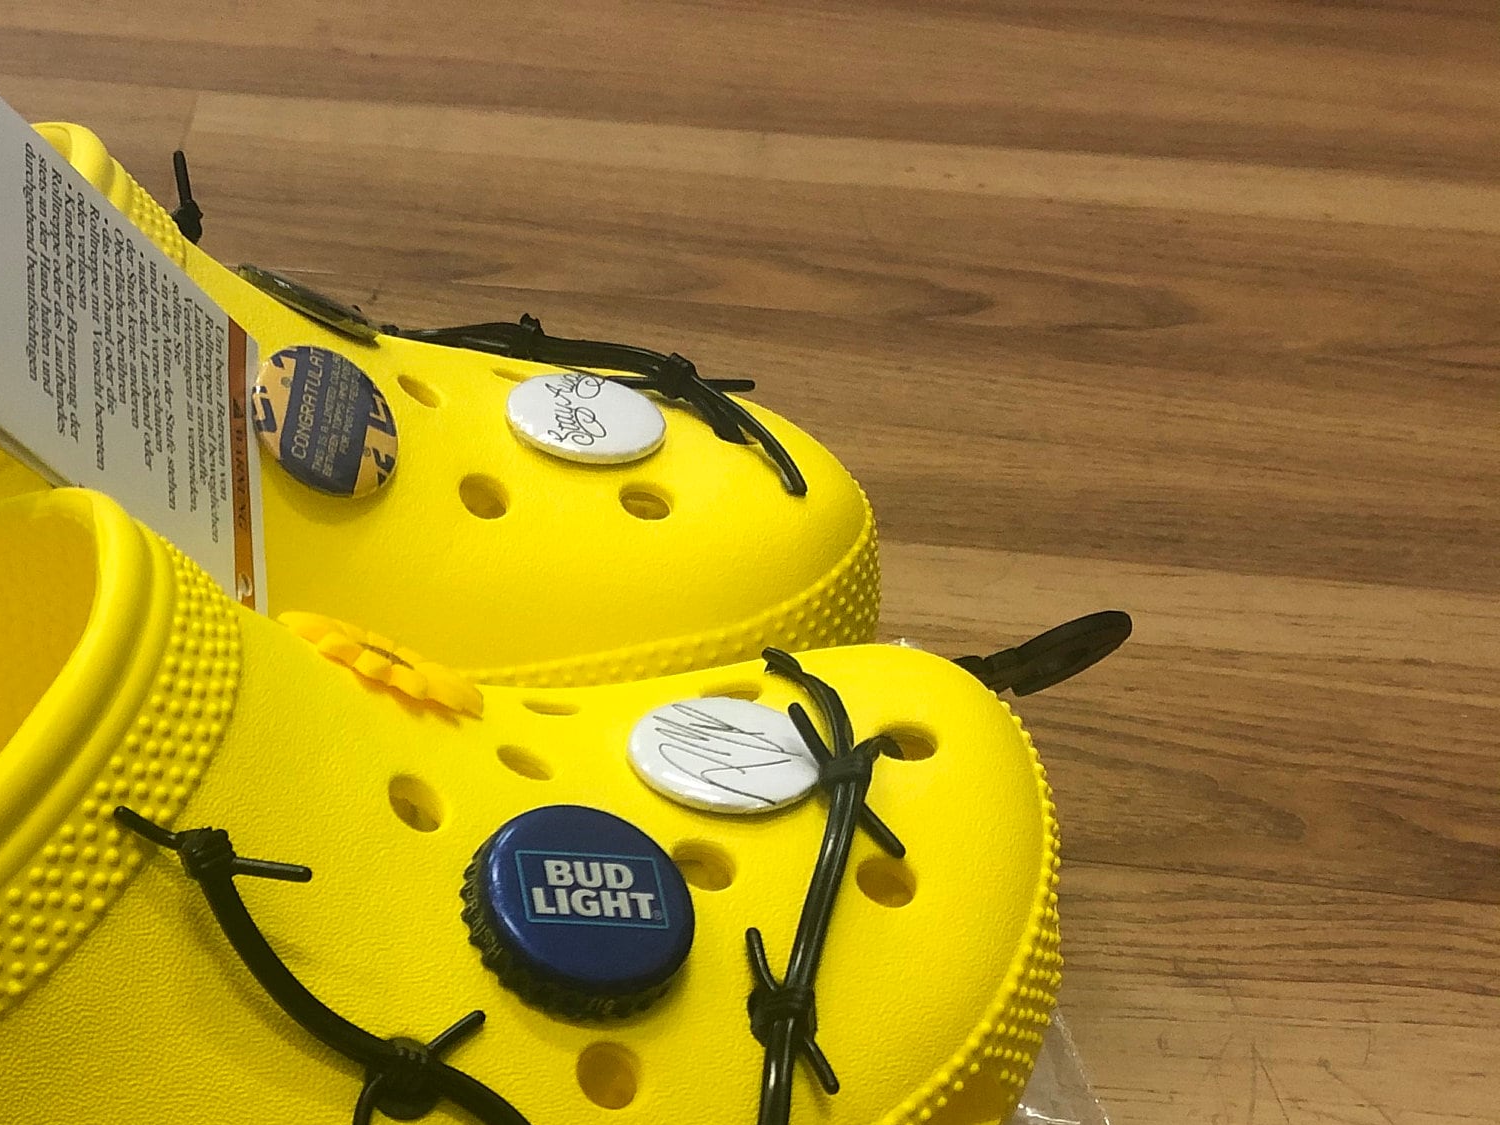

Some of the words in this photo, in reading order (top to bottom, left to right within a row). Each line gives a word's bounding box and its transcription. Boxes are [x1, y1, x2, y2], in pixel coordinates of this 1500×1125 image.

[38, 154, 48, 194] stets
[24, 142, 38, 255] durchgehend
[38, 196, 47, 218] an
[50, 168, 62, 256] Rolltreppe
[78, 192, 88, 232] oder
[40, 220, 50, 251] der
[64, 192, 76, 252] Kinder
[102, 228, 112, 257] das
[66, 254, 76, 284] bei
[88, 204, 100, 290] Rolltreppe
[126, 238, 136, 267] der
[40, 252, 52, 303] Hand
[52, 258, 64, 300] oder
[78, 235, 90, 310] verlassen
[114, 228, 126, 326] Oberflächen
[126, 268, 138, 312] Stufe
[138, 261, 148, 308] außer
[150, 260, 160, 295] und
[162, 283, 170, 300] in
[26, 256, 40, 380] beaufsichtigen
[54, 300, 64, 331] des
[66, 284, 76, 314] der
[92, 292, 102, 324] mit
[102, 259, 114, 346] Laufband
[150, 294, 160, 334] nach
[162, 303, 172, 332] der
[172, 282, 182, 334] sollten
[40, 302, 52, 356] halten
[128, 314, 138, 360] keine
[140, 310, 150, 346] dem
[184, 298, 192, 398] Verletzungen
[216, 325, 224, 354] Um
[66, 316, 78, 408] Benutzung
[92, 330, 104, 400] Vorsicht
[104, 346, 116, 386] oder
[116, 330, 128, 404] berühren
[162, 332, 172, 378] Mitte
[174, 338, 182, 366] Sie
[194, 303, 206, 404] Laufbändern
[202, 311, 214, 404] Rolltreppen
[42, 360, 54, 398] und
[54, 334, 68, 436] Laufbandes
[130, 362, 140, 429] anderen
[140, 350, 152, 430] Laufband
[164, 380, 174, 409] der
[216, 358, 224, 398] beim
[106, 387, 118, 416] die
[154, 386, 164, 452] schauen
[186, 400, 194, 422] zu
[70, 412, 80, 444] der
[94, 402, 105, 471] betreten
[166, 410, 176, 454] Stufe
[198, 406, 208, 485] ernsthafte
[208, 408, 216, 442] und
[216, 401, 226, 466] Betreten
[144, 432, 154, 472] oder
[168, 456, 178, 510] stehen
[206, 443, 220, 543] beweglichen
[543, 859, 634, 889] BUD
[531, 886, 655, 920] LIGHT
